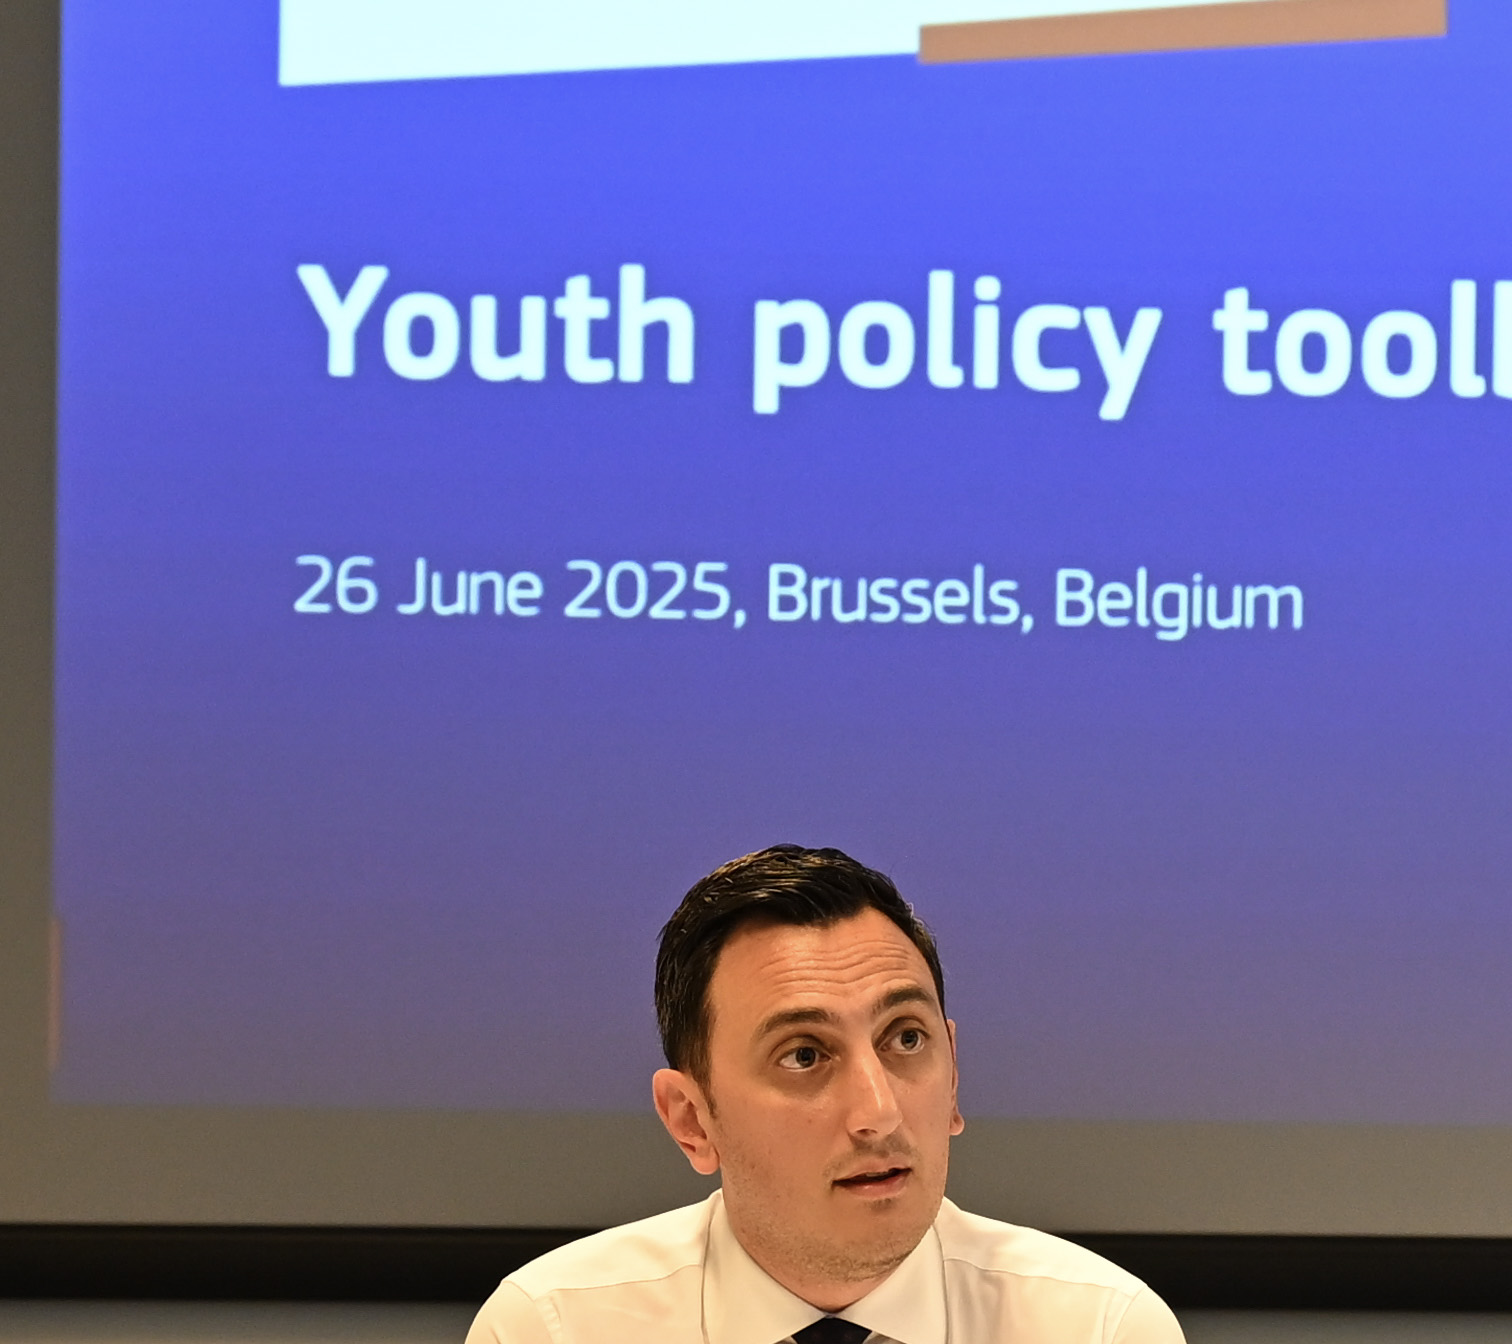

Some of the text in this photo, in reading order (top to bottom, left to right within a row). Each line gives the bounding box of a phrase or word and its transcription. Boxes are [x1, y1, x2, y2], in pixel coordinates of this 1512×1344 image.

[296, 262, 696, 384] Youth
[752, 268, 1165, 422] policy
[292, 556, 1305, 643] 26 June 2025, Brussels, Belgium
